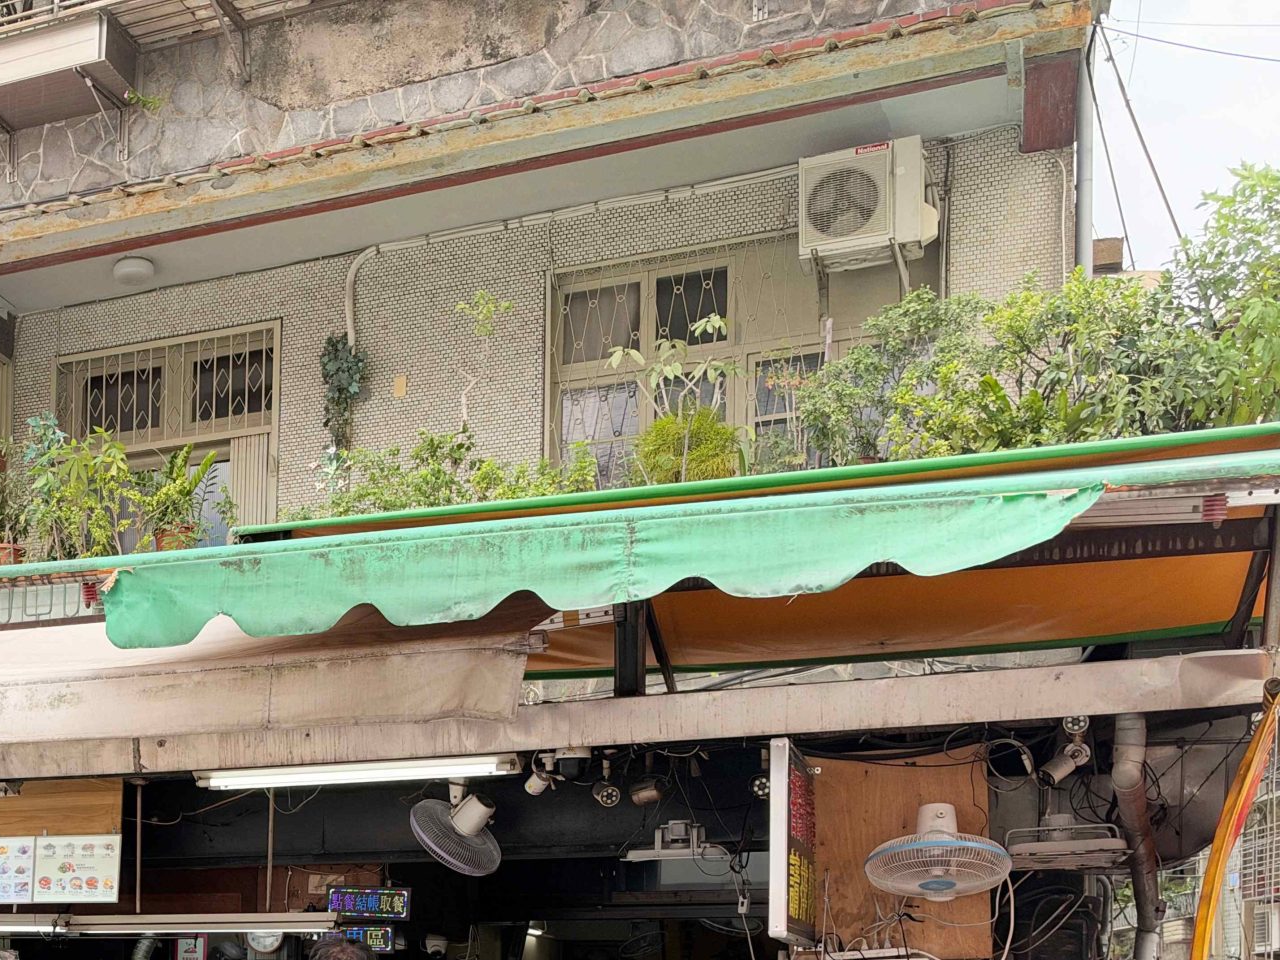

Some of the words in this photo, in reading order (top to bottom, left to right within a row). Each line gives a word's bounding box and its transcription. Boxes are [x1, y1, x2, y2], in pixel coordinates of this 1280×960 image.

[857, 143, 888, 155] National
[331, 893, 404, 912] 點餐結帳取餐
